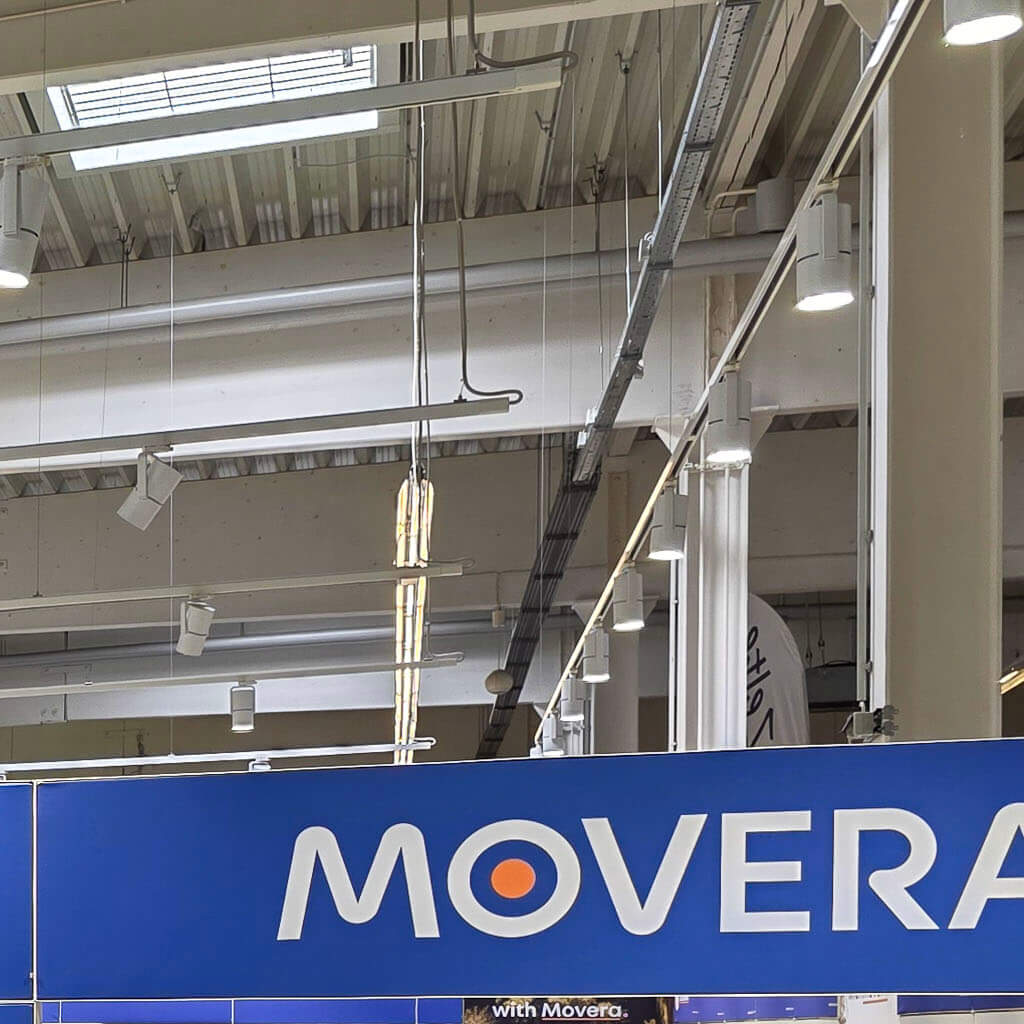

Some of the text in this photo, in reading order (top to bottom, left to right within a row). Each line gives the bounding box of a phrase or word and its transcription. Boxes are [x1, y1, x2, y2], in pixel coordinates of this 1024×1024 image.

[277, 802, 1024, 940] MOVERA
[492, 1003, 629, 1018] with Movera.
